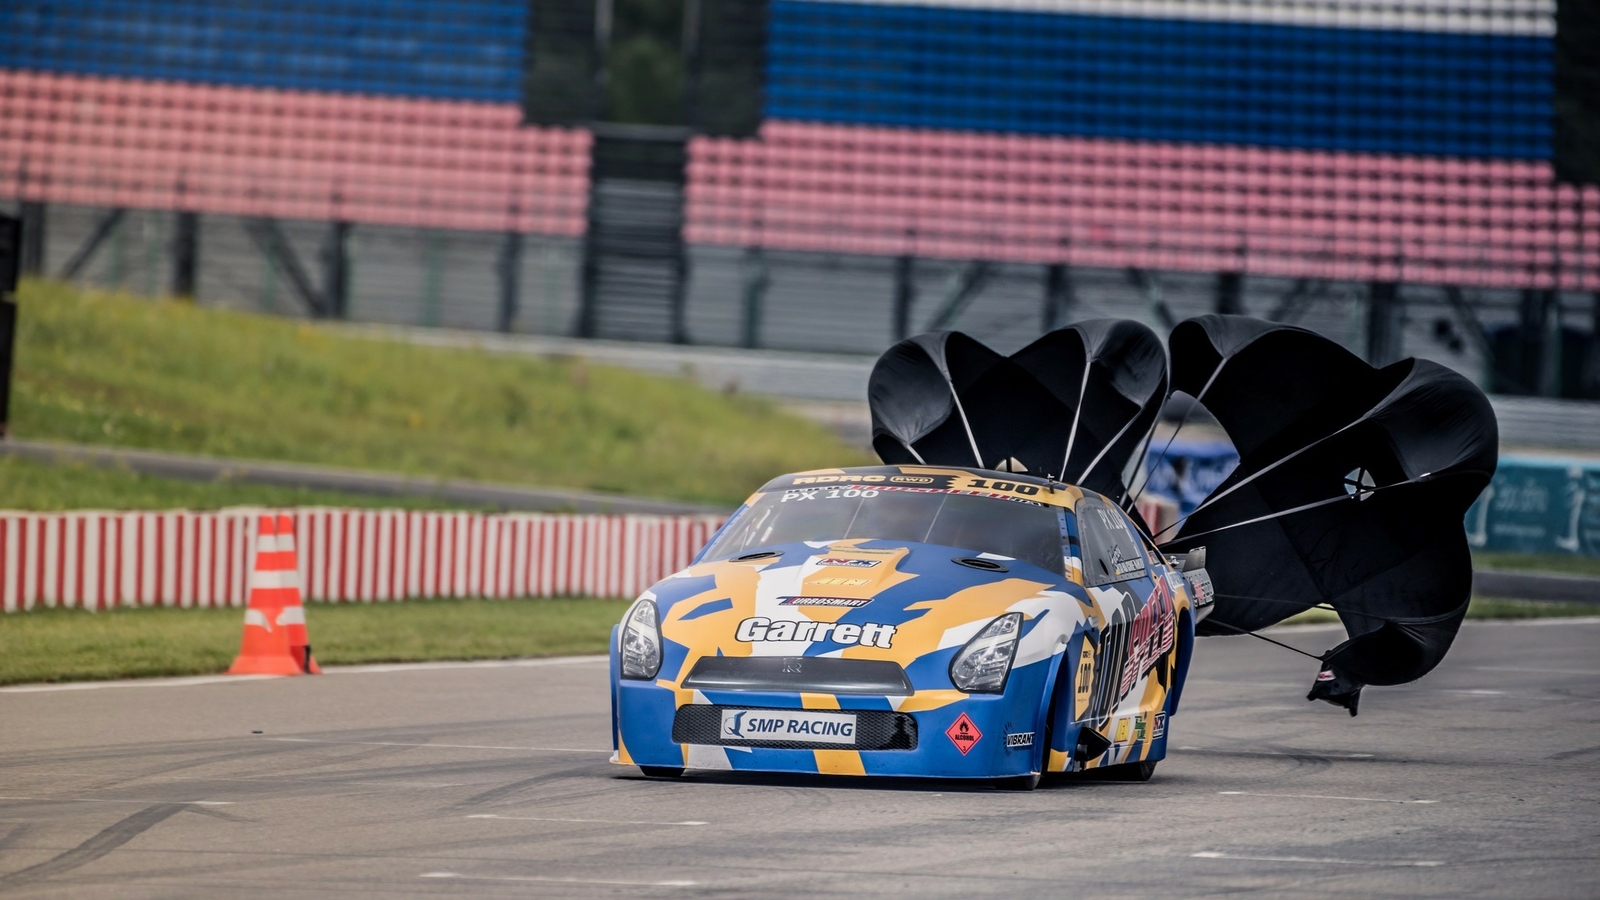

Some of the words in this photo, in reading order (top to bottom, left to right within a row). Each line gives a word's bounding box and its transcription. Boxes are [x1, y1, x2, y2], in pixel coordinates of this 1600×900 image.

[781, 491, 820, 503] PX
[826, 489, 880, 499] 100
[967, 479, 1040, 496] 100
[735, 617, 897, 649] Garrett
[1078, 663, 1091, 693] 100
[747, 718, 784, 733] SMP
[786, 719, 853, 736] RACING
